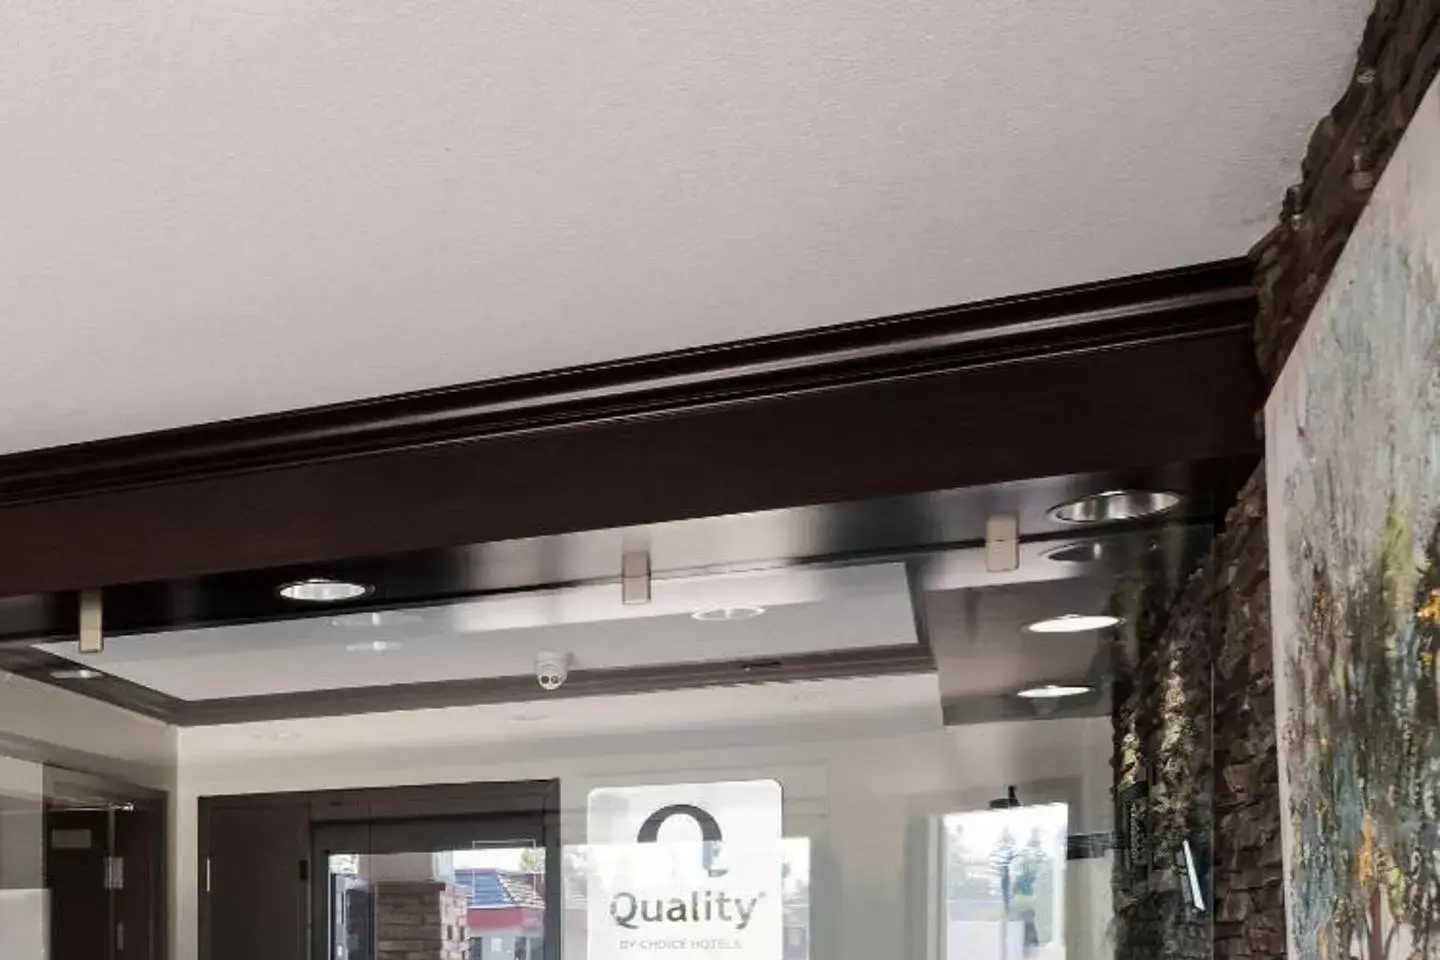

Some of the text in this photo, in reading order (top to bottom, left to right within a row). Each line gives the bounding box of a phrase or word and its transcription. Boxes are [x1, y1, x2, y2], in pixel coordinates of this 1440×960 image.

[610, 890, 759, 930] Quality
[640, 940, 687, 950] CHOICE
[690, 940, 742, 950] HOTELS
